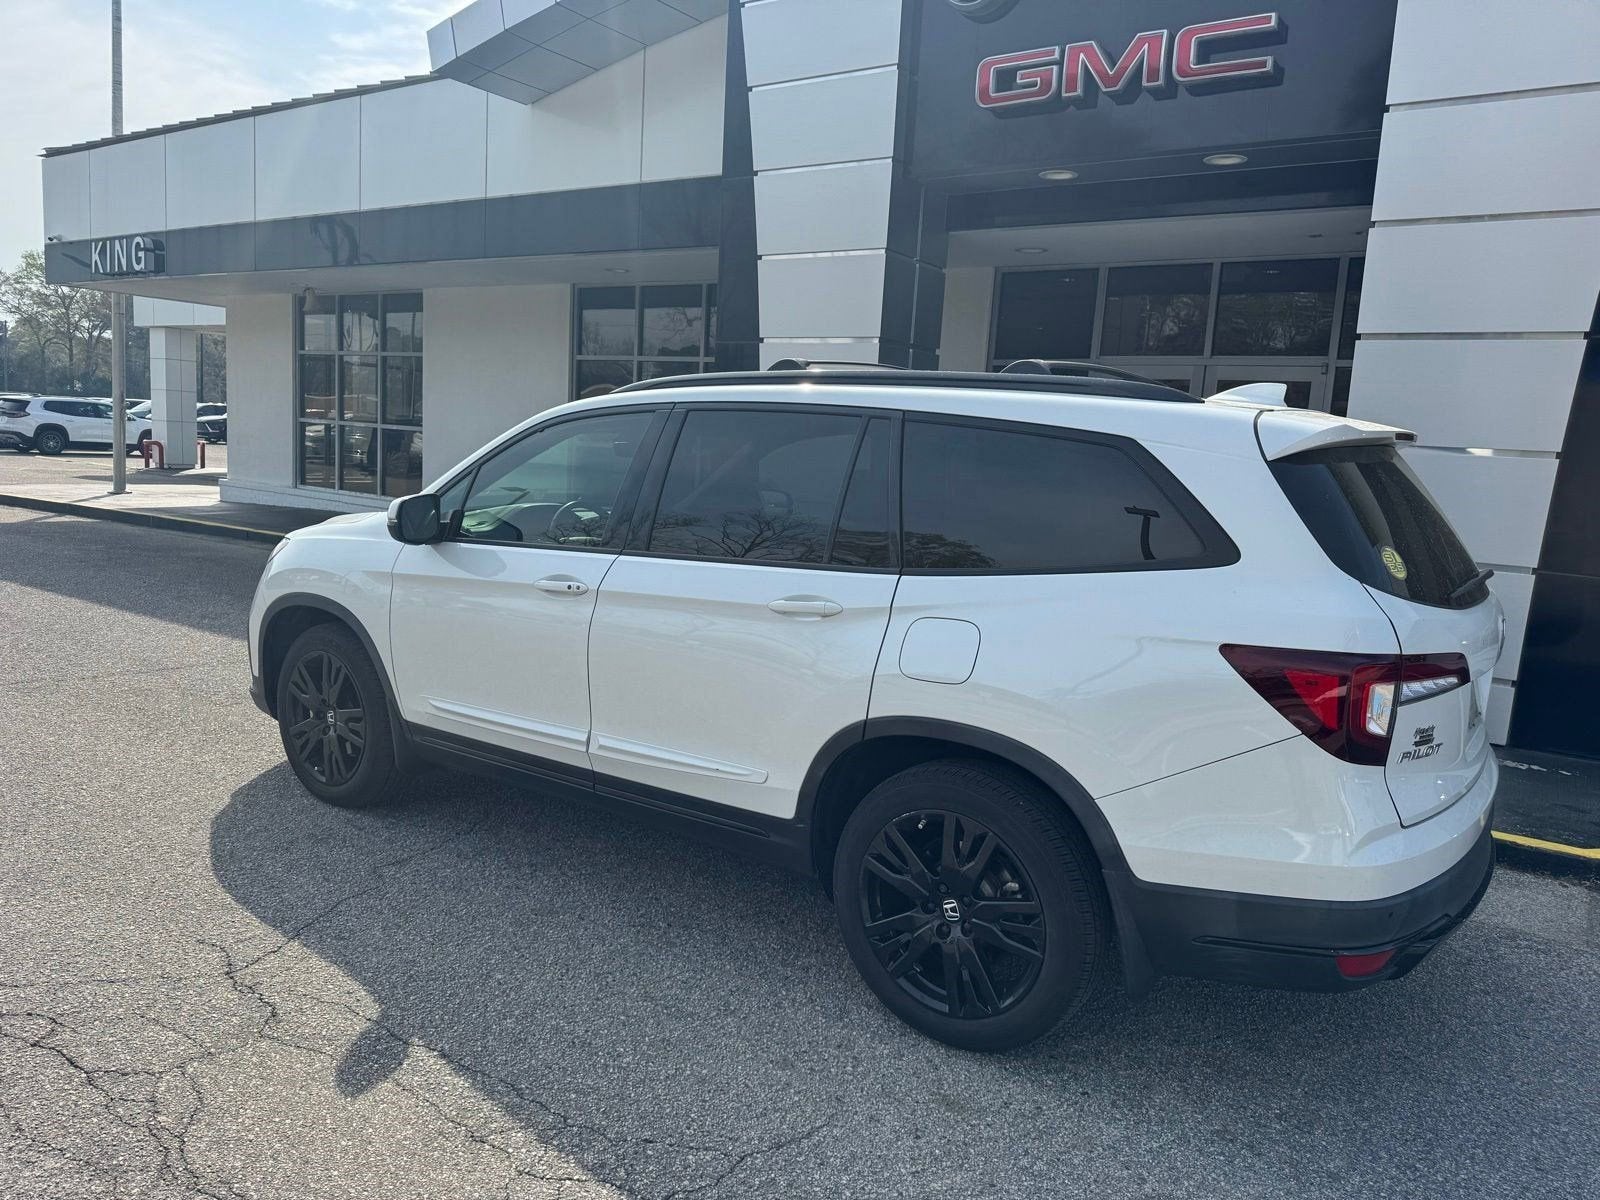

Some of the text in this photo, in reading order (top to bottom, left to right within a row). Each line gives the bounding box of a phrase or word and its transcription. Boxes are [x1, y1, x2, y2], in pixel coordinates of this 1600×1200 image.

[975, 12, 1278, 108] GMC
[91, 236, 145, 273] KING
[1397, 742, 1443, 764] PILOT
